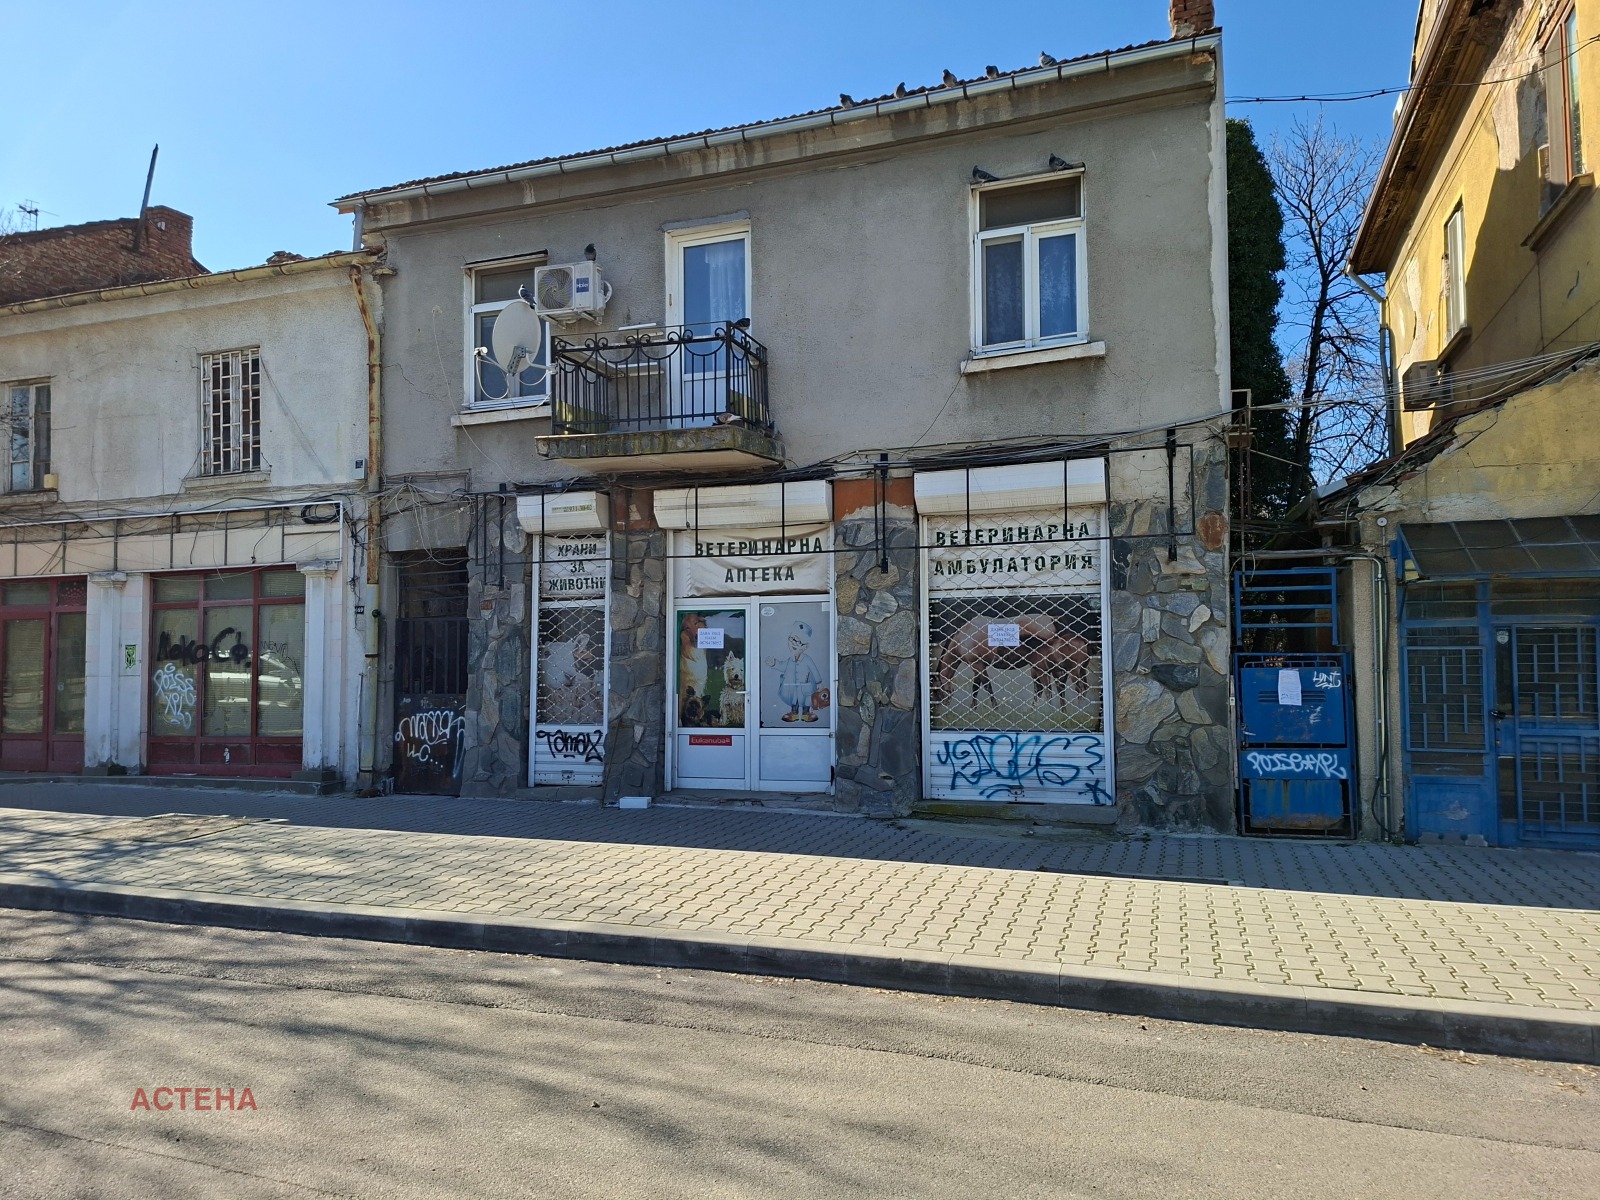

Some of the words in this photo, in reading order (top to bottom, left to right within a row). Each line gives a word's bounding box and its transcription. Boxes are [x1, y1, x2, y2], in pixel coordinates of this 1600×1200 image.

[936, 522, 1090, 546] ВЕТЕРИНАРНА
[557, 543, 596, 557] ХРАНИ
[695, 537, 823, 556] ВЕТЕРИНАРНА
[570, 561, 585, 573] ЗА
[933, 554, 1093, 576] АМБУЛАТОРИЯ
[724, 566, 795, 583] АПТЕКА
[691, 736, 726, 744] Eukanuba
